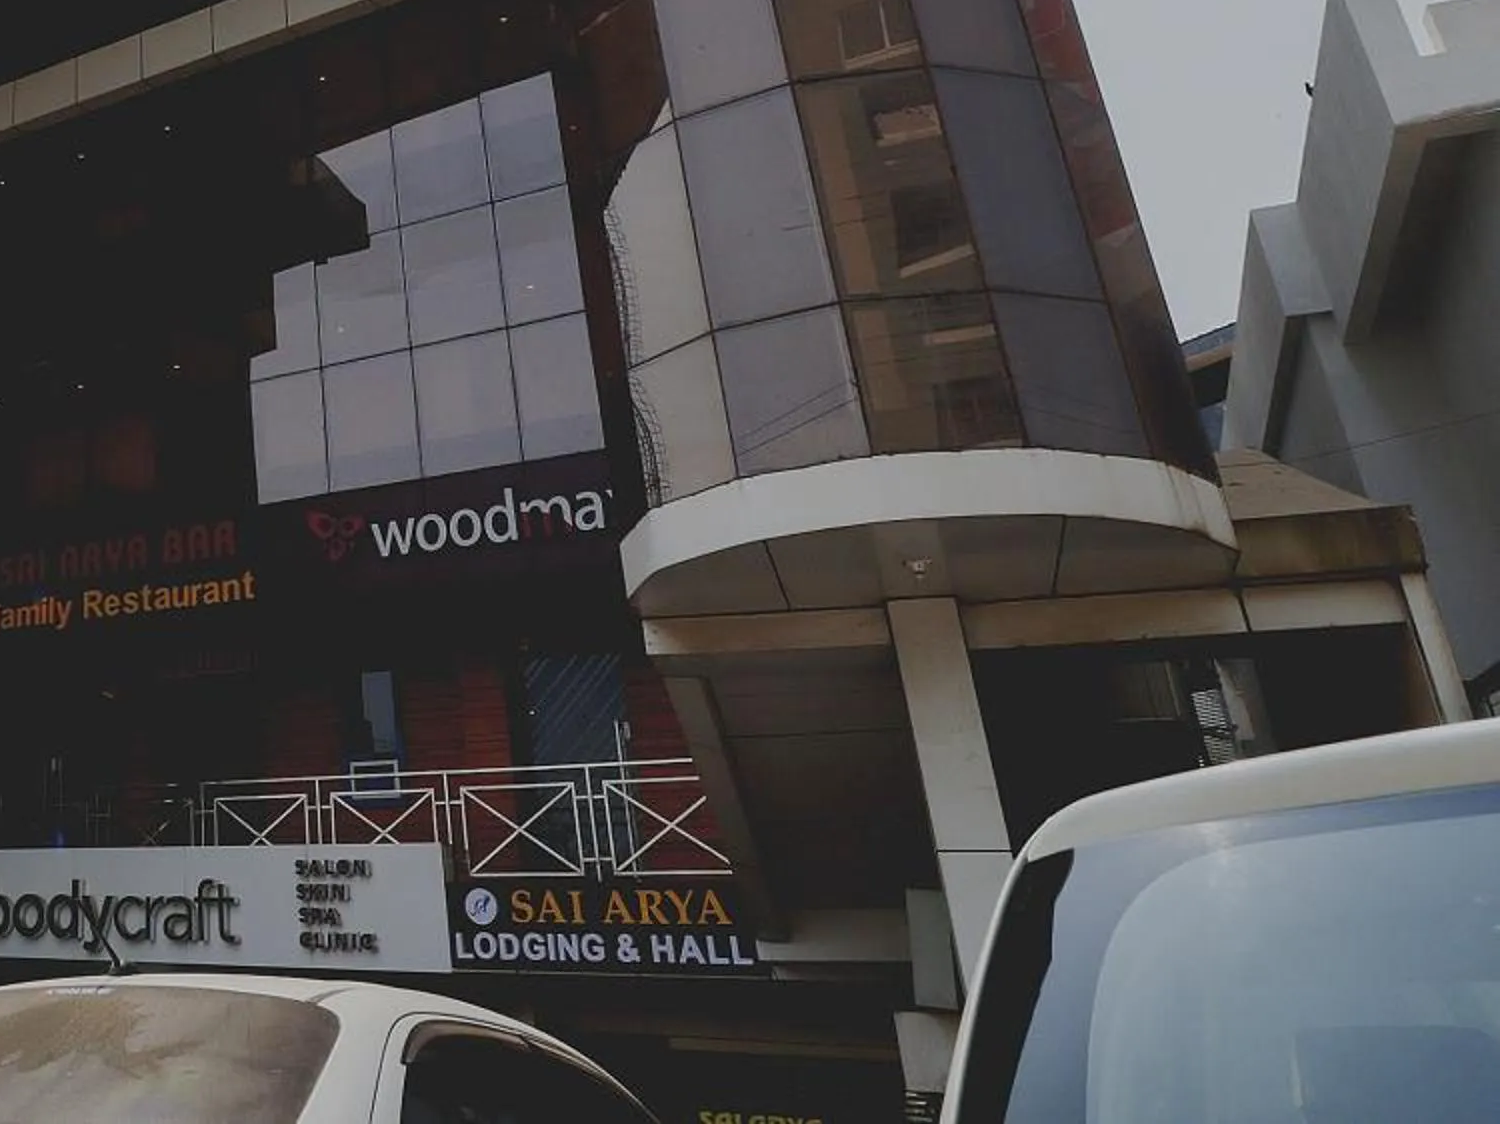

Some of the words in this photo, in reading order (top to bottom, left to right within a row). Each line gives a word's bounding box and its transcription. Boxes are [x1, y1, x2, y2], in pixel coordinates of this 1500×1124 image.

[371, 487, 613, 557] woodma
[82, 570, 257, 619] Restaurant
[295, 859, 370, 876] SALON
[296, 883, 348, 901] SKIN
[298, 907, 341, 925] SPA
[511, 889, 586, 924] SAI
[603, 888, 734, 925] ARYA
[299, 931, 377, 952] CLINIC
[455, 932, 606, 962] LODGING
[616, 933, 642, 964] &
[650, 934, 755, 966] HALL
